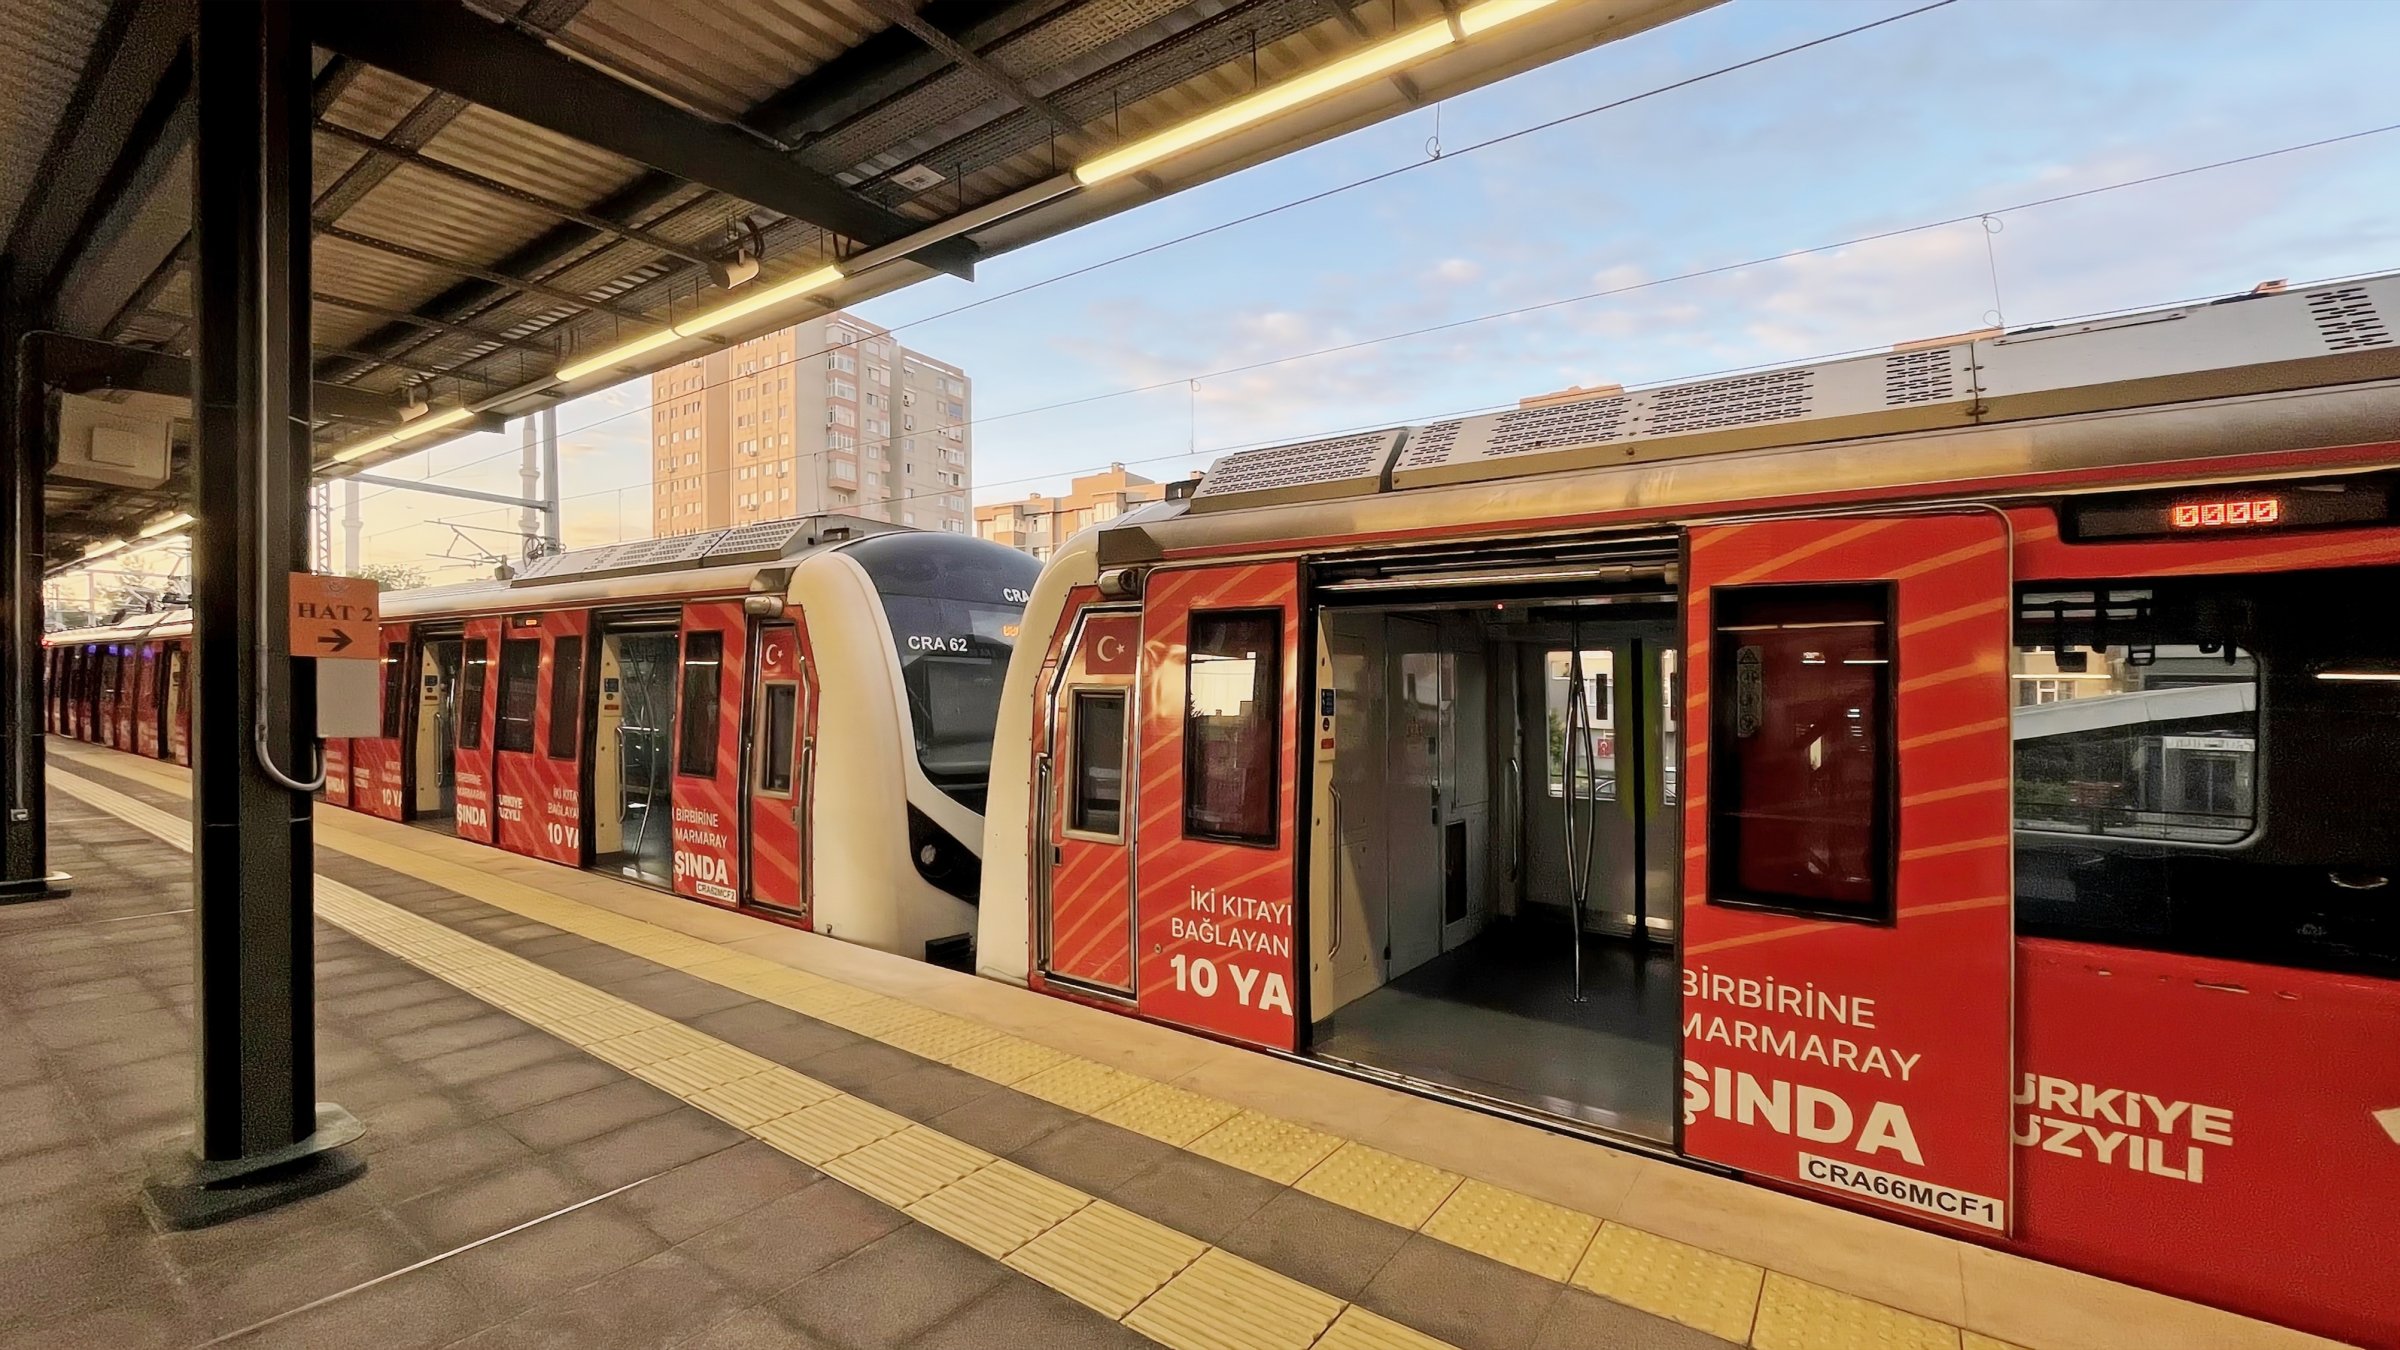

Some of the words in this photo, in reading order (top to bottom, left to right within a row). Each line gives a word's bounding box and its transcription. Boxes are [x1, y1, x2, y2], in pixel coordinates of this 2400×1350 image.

[298, 602, 355, 620] HAT
[361, 607, 373, 622] 2
[1003, 588, 1030, 603] CRA
[908, 636, 947, 651] CRA
[949, 638, 968, 652] 62
[548, 823, 564, 845] 10
[676, 805, 719, 828] BİRBİRİNE
[675, 828, 728, 849] MARMARAY
[674, 850, 729, 885] ŞINDA
[1190, 885, 1215, 914] İKİ
[1222, 894, 1292, 926] KITAYI
[1171, 917, 1289, 958] BAĞLAYAN
[1170, 953, 1219, 998] 10
[1228, 963, 1293, 1016] YA
[1683, 965, 1876, 1029] BİRBİRİNE
[1683, 1059, 1925, 1167] ŞINDA
[1807, 1160, 1995, 1223] CRA66MCF1
